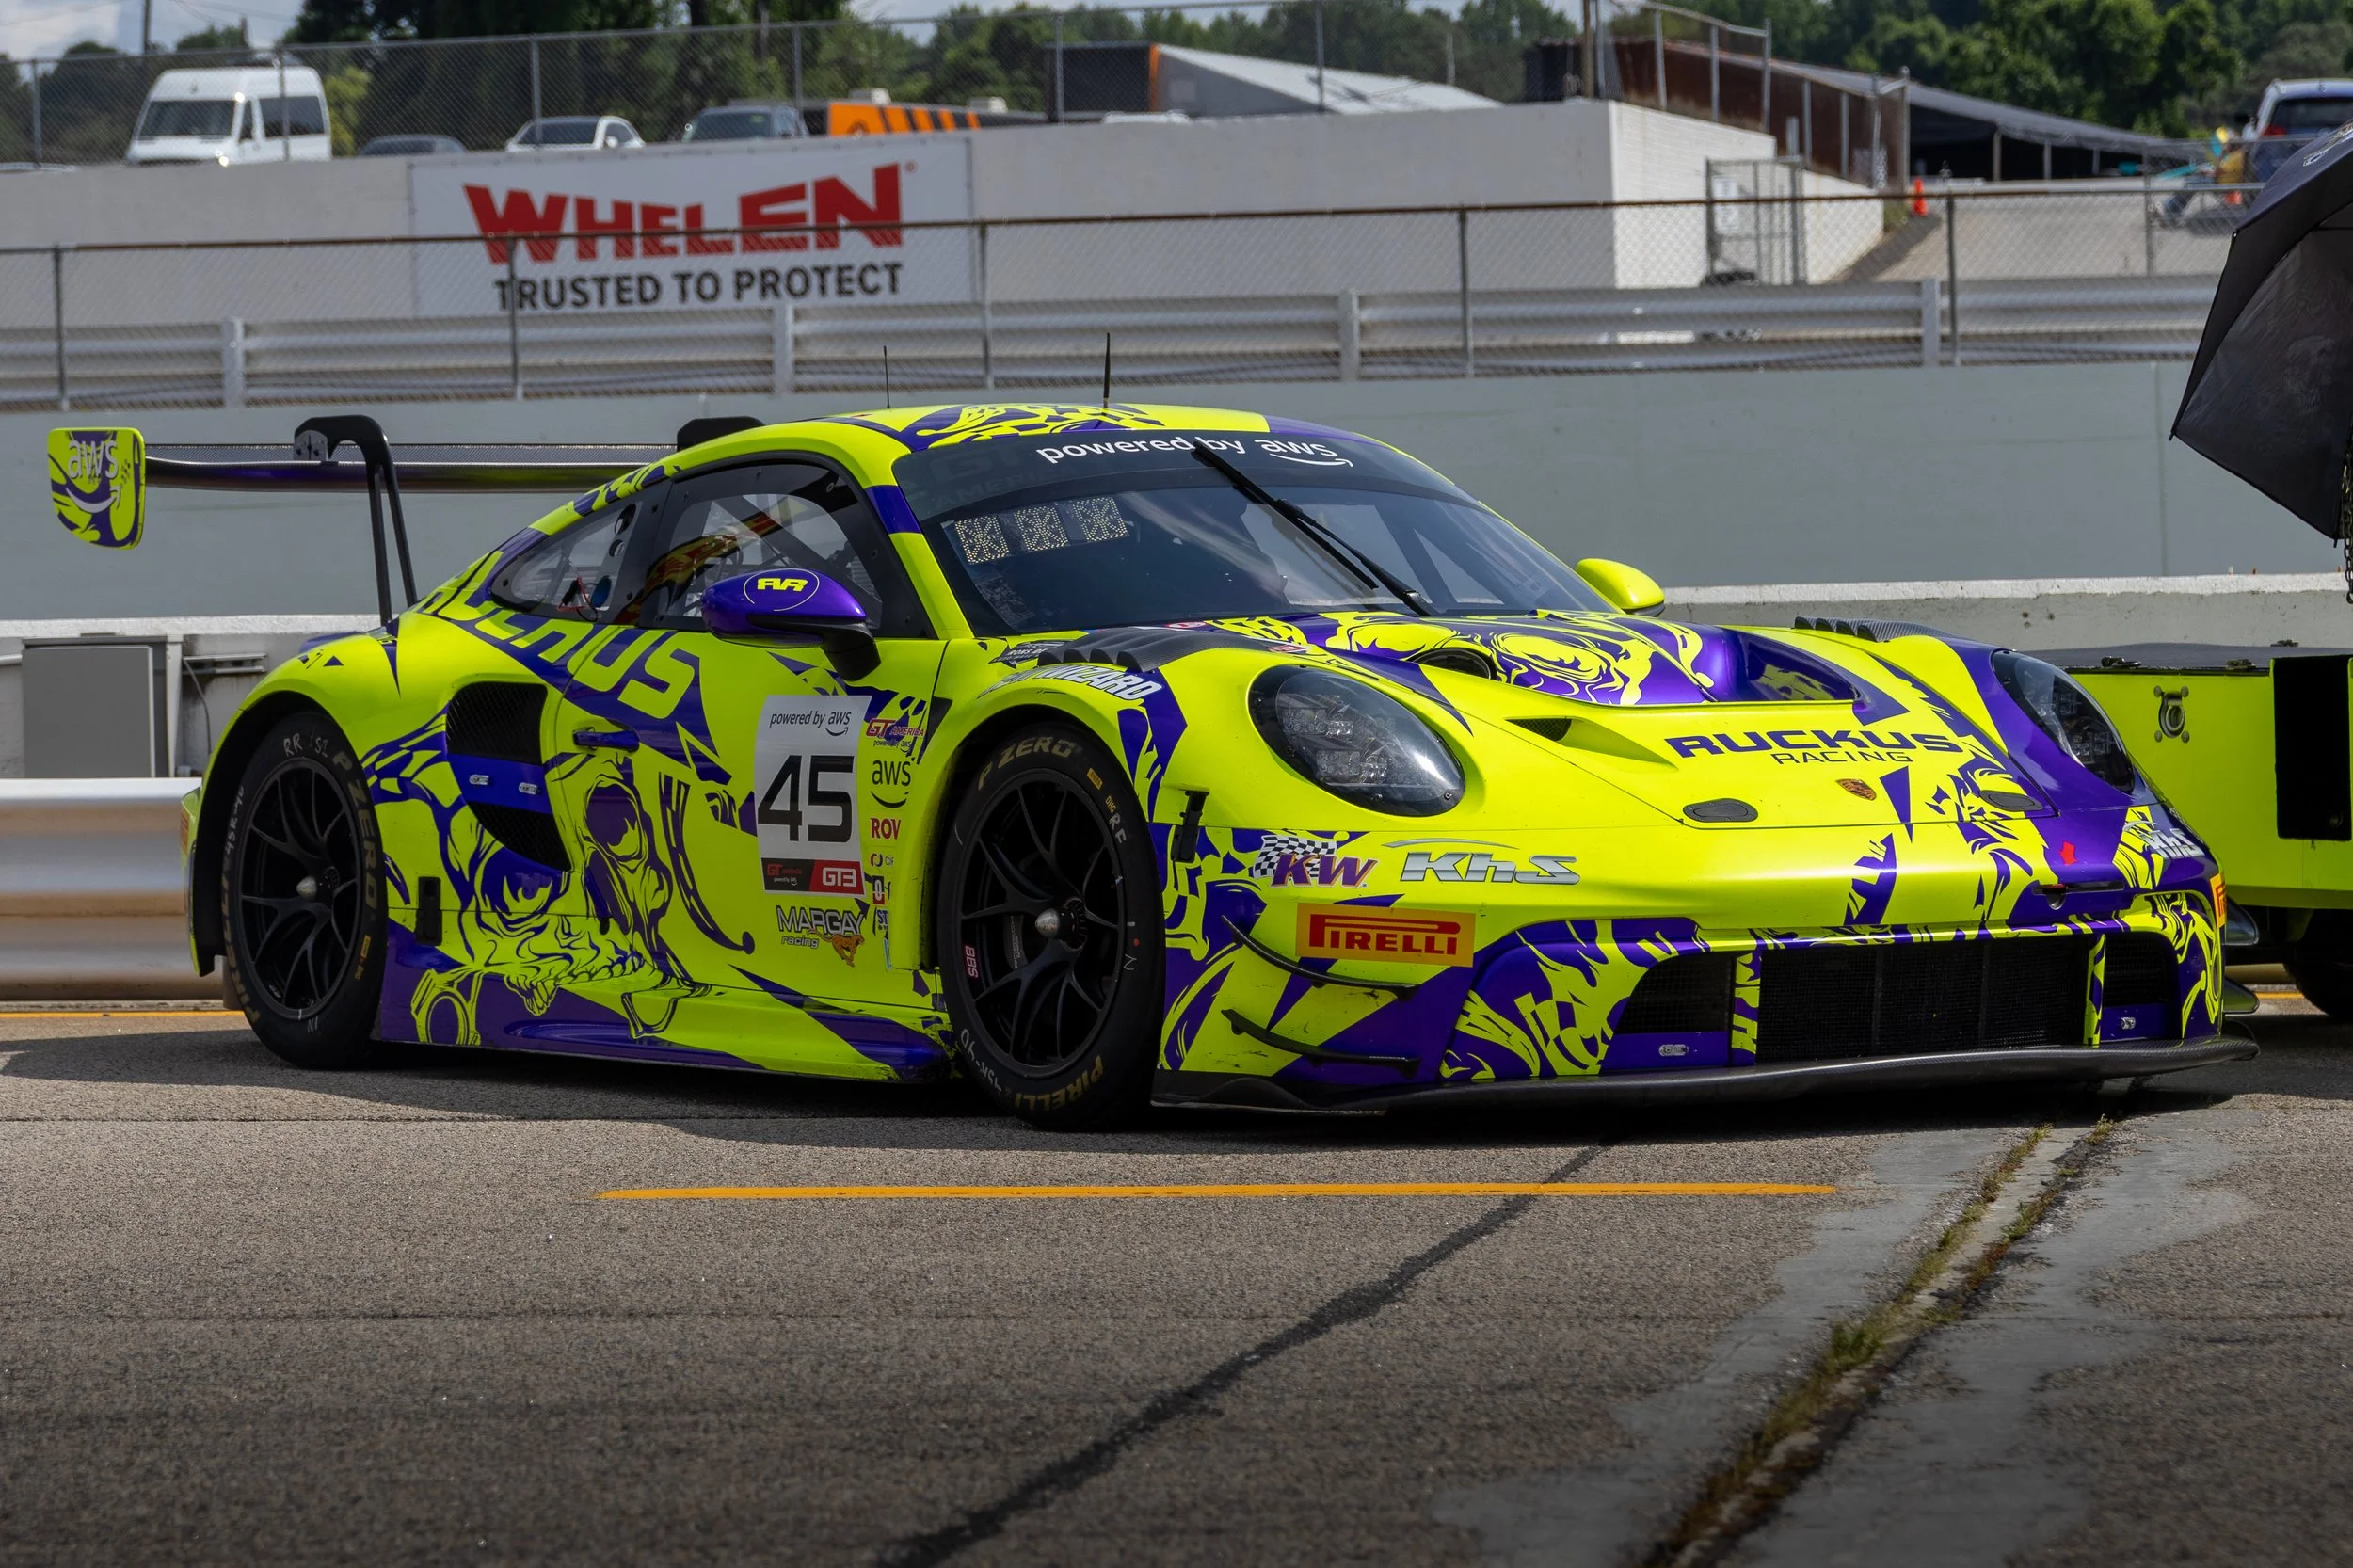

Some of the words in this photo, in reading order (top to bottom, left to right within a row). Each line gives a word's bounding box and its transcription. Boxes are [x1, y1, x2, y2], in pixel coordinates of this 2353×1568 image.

[462, 162, 903, 264] WHELEN
[493, 273, 663, 311] TRUSTED
[672, 269, 722, 303] TO
[733, 262, 903, 301] PROTECT
[1036, 436, 1195, 464] powered
[1194, 436, 1246, 455] by
[1254, 440, 1338, 458] aws
[770, 711, 812, 728] powered
[812, 711, 826, 728] by
[828, 711, 851, 725] aws
[865, 719, 896, 737] GT
[998, 736, 1076, 769] ZERO
[1664, 730, 1963, 758] RUCKUS
[1770, 751, 1913, 764] RACING
[872, 760, 911, 787] aws
[757, 755, 855, 843] 45
[822, 867, 856, 888] GT3
[1271, 852, 1379, 888] KW
[776, 905, 864, 935] MARGAY
[1309, 914, 1461, 956] PIRELLI
[781, 935, 820, 949] racing
[964, 944, 980, 980] BBS
[1014, 1054, 1104, 1112] PIRELLI
